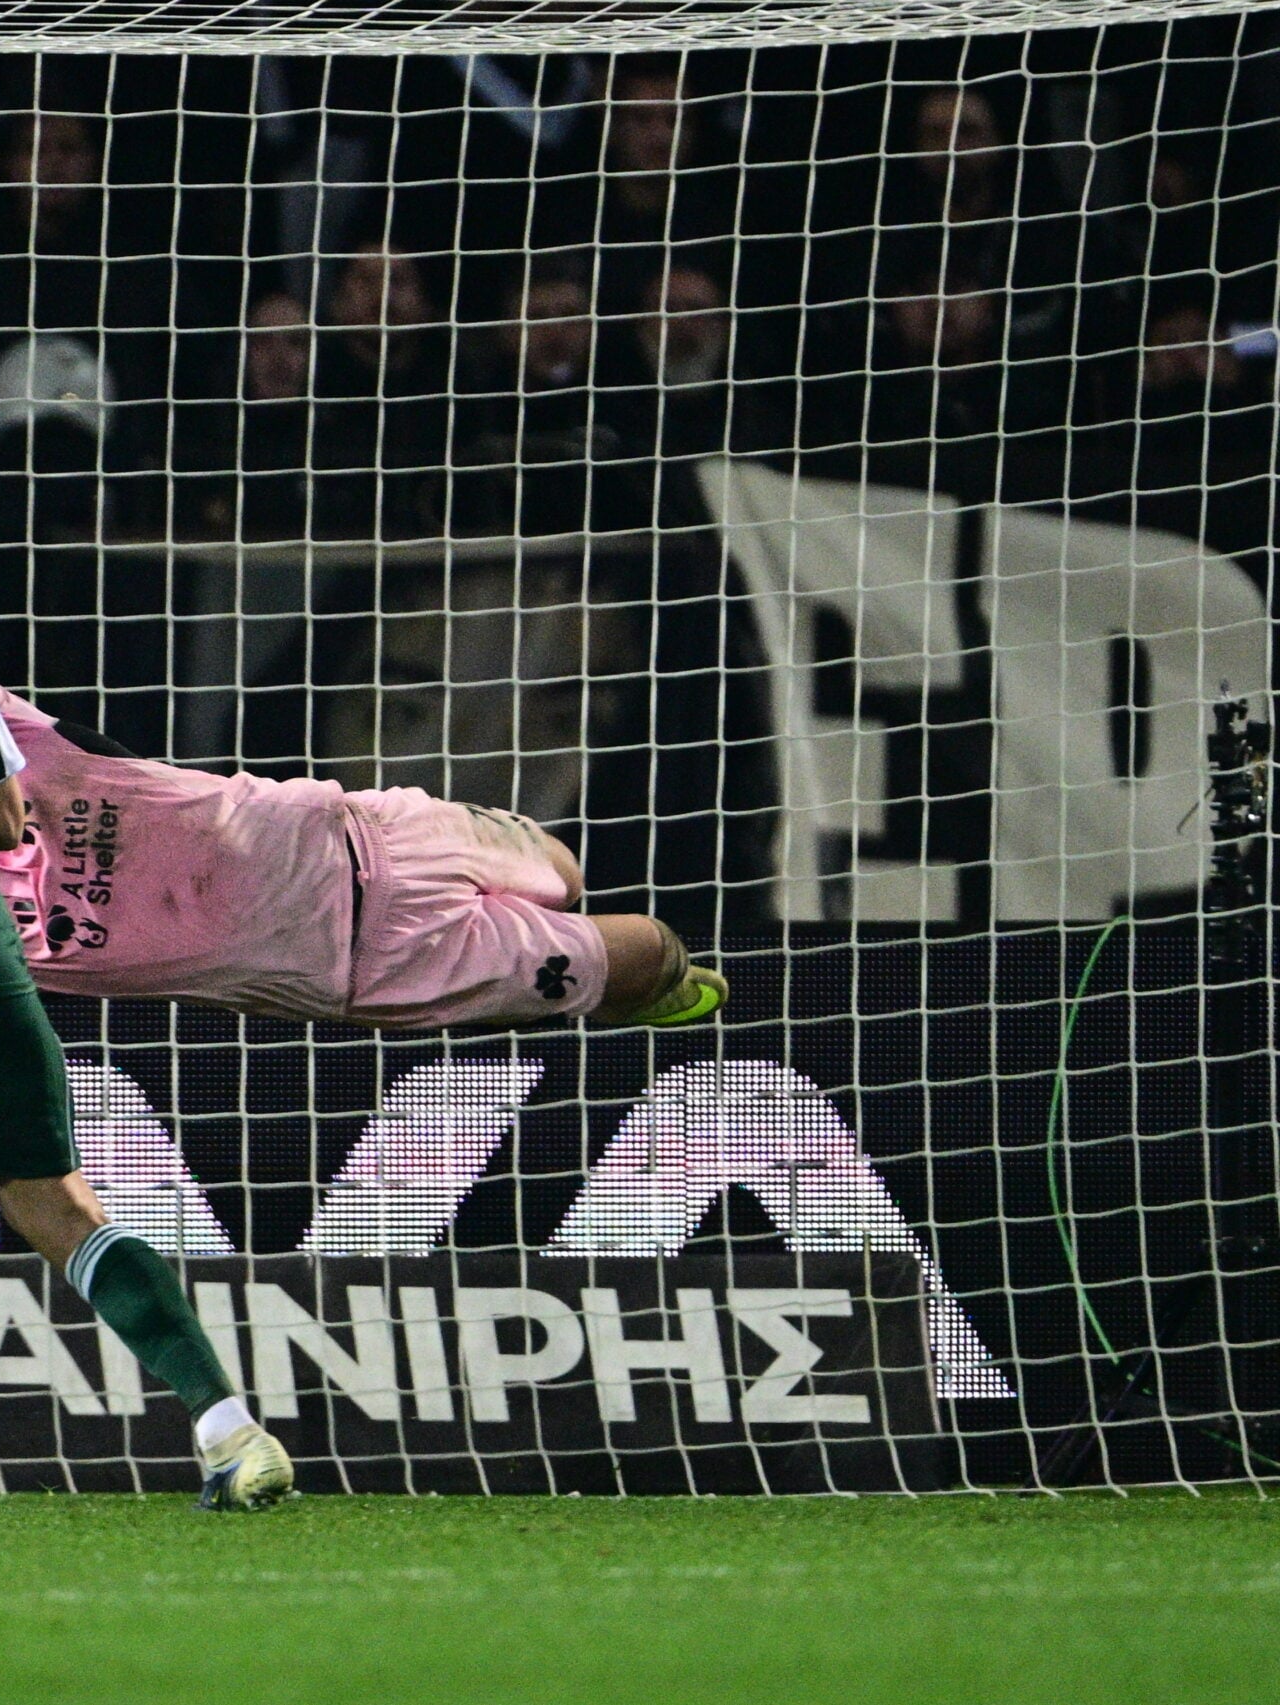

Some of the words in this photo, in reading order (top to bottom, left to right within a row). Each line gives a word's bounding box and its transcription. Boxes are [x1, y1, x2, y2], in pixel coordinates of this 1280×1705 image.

[63, 799, 90, 875] Little
[87, 798, 119, 905] Shelter
[60, 882, 86, 901] A
